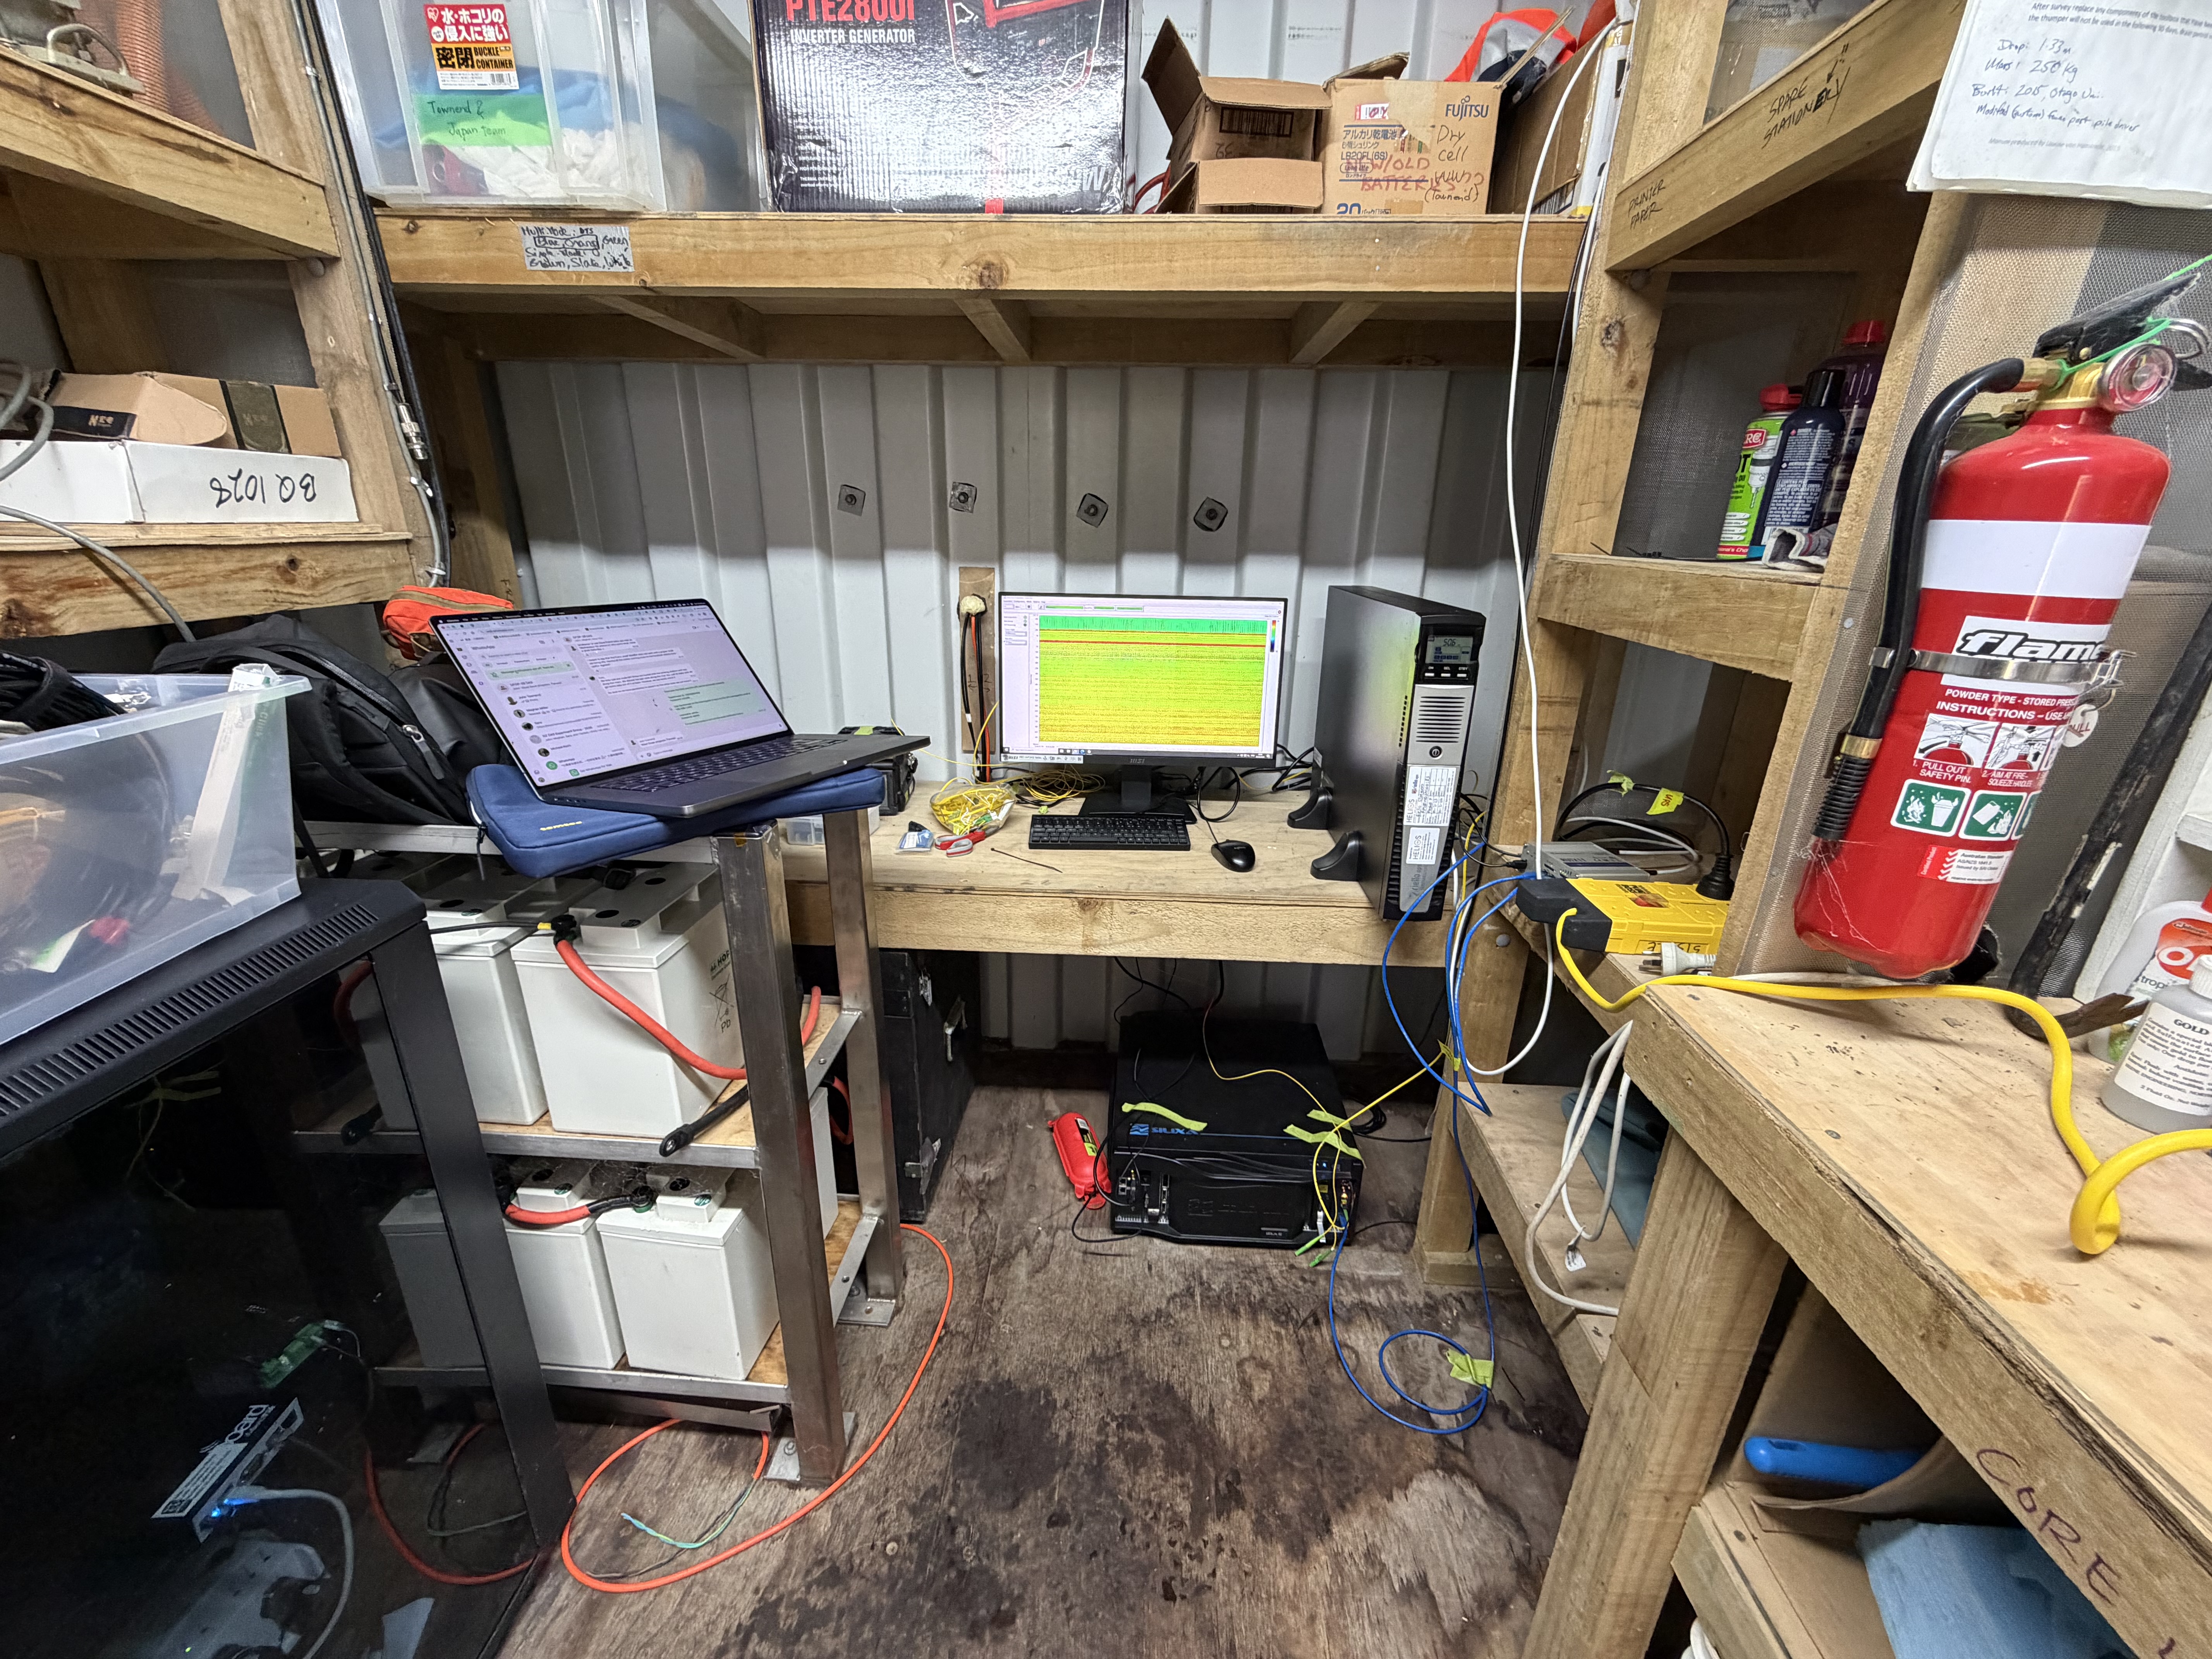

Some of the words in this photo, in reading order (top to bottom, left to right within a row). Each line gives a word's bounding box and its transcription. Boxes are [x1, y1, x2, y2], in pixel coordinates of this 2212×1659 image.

[441, 8, 504, 24] 水・ホコリの
[2051, 4, 2071, 12] survey
[2028, 14, 2039, 22] the
[2041, 15, 2068, 24] thumper
[445, 24, 508, 42] 侵入に強い
[790, 29, 845, 43] INVERTER
[849, 29, 915, 43] GENERATOR
[435, 47, 475, 69] 密閉
[474, 47, 500, 57] BUCKLE
[476, 59, 514, 69] CONTAINER
[2029, 60, 2061, 73] 250
[428, 100, 471, 114] Townend
[1767, 76, 1808, 123] SPARE
[1445, 96, 1489, 122] FUJITSU
[447, 122, 478, 141] Japan
[1343, 129, 1397, 140] アルカリ乾電池
[1437, 125, 1465, 148] Dry
[1438, 146, 1468, 162] cell
[984, 674, 992, 683] 2
[1945, 689, 1989, 701] POWDER
[1991, 694, 2017, 704] TYPE
[2023, 697, 2055, 707] STORED
[1936, 701, 2035, 720] INSTRUCTIONS
[2045, 712, 2063, 721] USE
[1922, 761, 1944, 771] PULL
[1946, 764, 1966, 774] OUT
[1920, 769, 1954, 780] SAFETY
[1954, 775, 1971, 783] PIN.
[1987, 778, 2013, 787] SQUEEZE
[1406, 799, 1415, 823] HELIOS
[1413, 835, 1421, 860] HELIOS
[2174, 1019, 2210, 1035] GOLD
[1976, 1448, 2122, 1607] CORE
